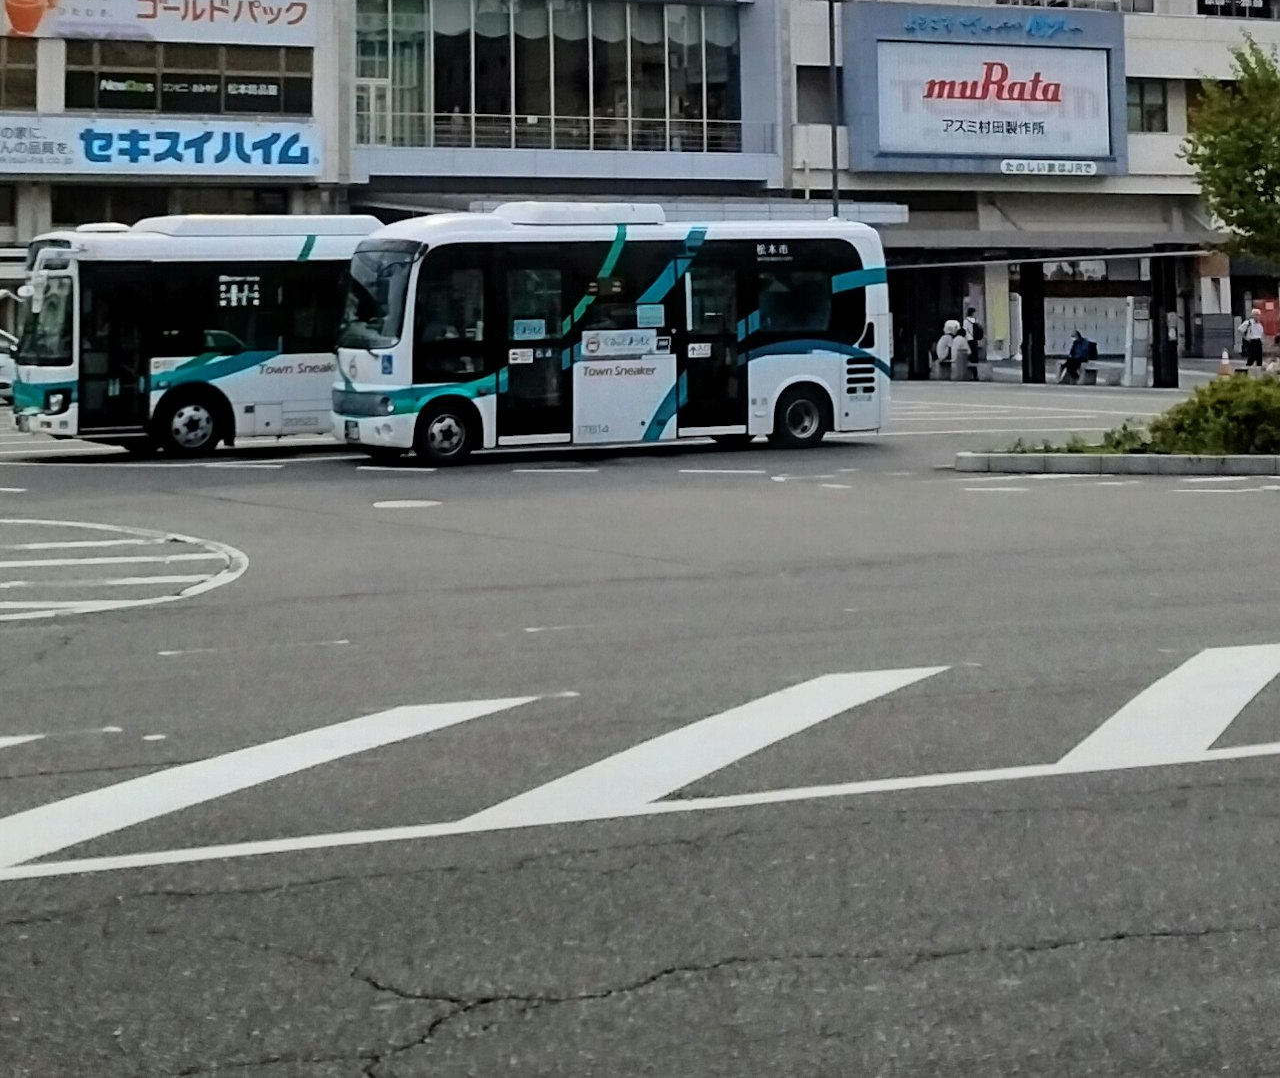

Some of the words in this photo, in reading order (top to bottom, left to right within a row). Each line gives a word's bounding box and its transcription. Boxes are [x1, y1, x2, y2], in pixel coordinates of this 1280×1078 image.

[923, 62, 1061, 102] muRata
[941, 119, 1046, 136] アズミ村田製作所
[79, 128, 310, 165] セキスイハイム
[756, 243, 789, 255] 松本市
[260, 364, 294, 374] Town
[583, 366, 613, 376] Town
[614, 365, 657, 376] Sneaker
